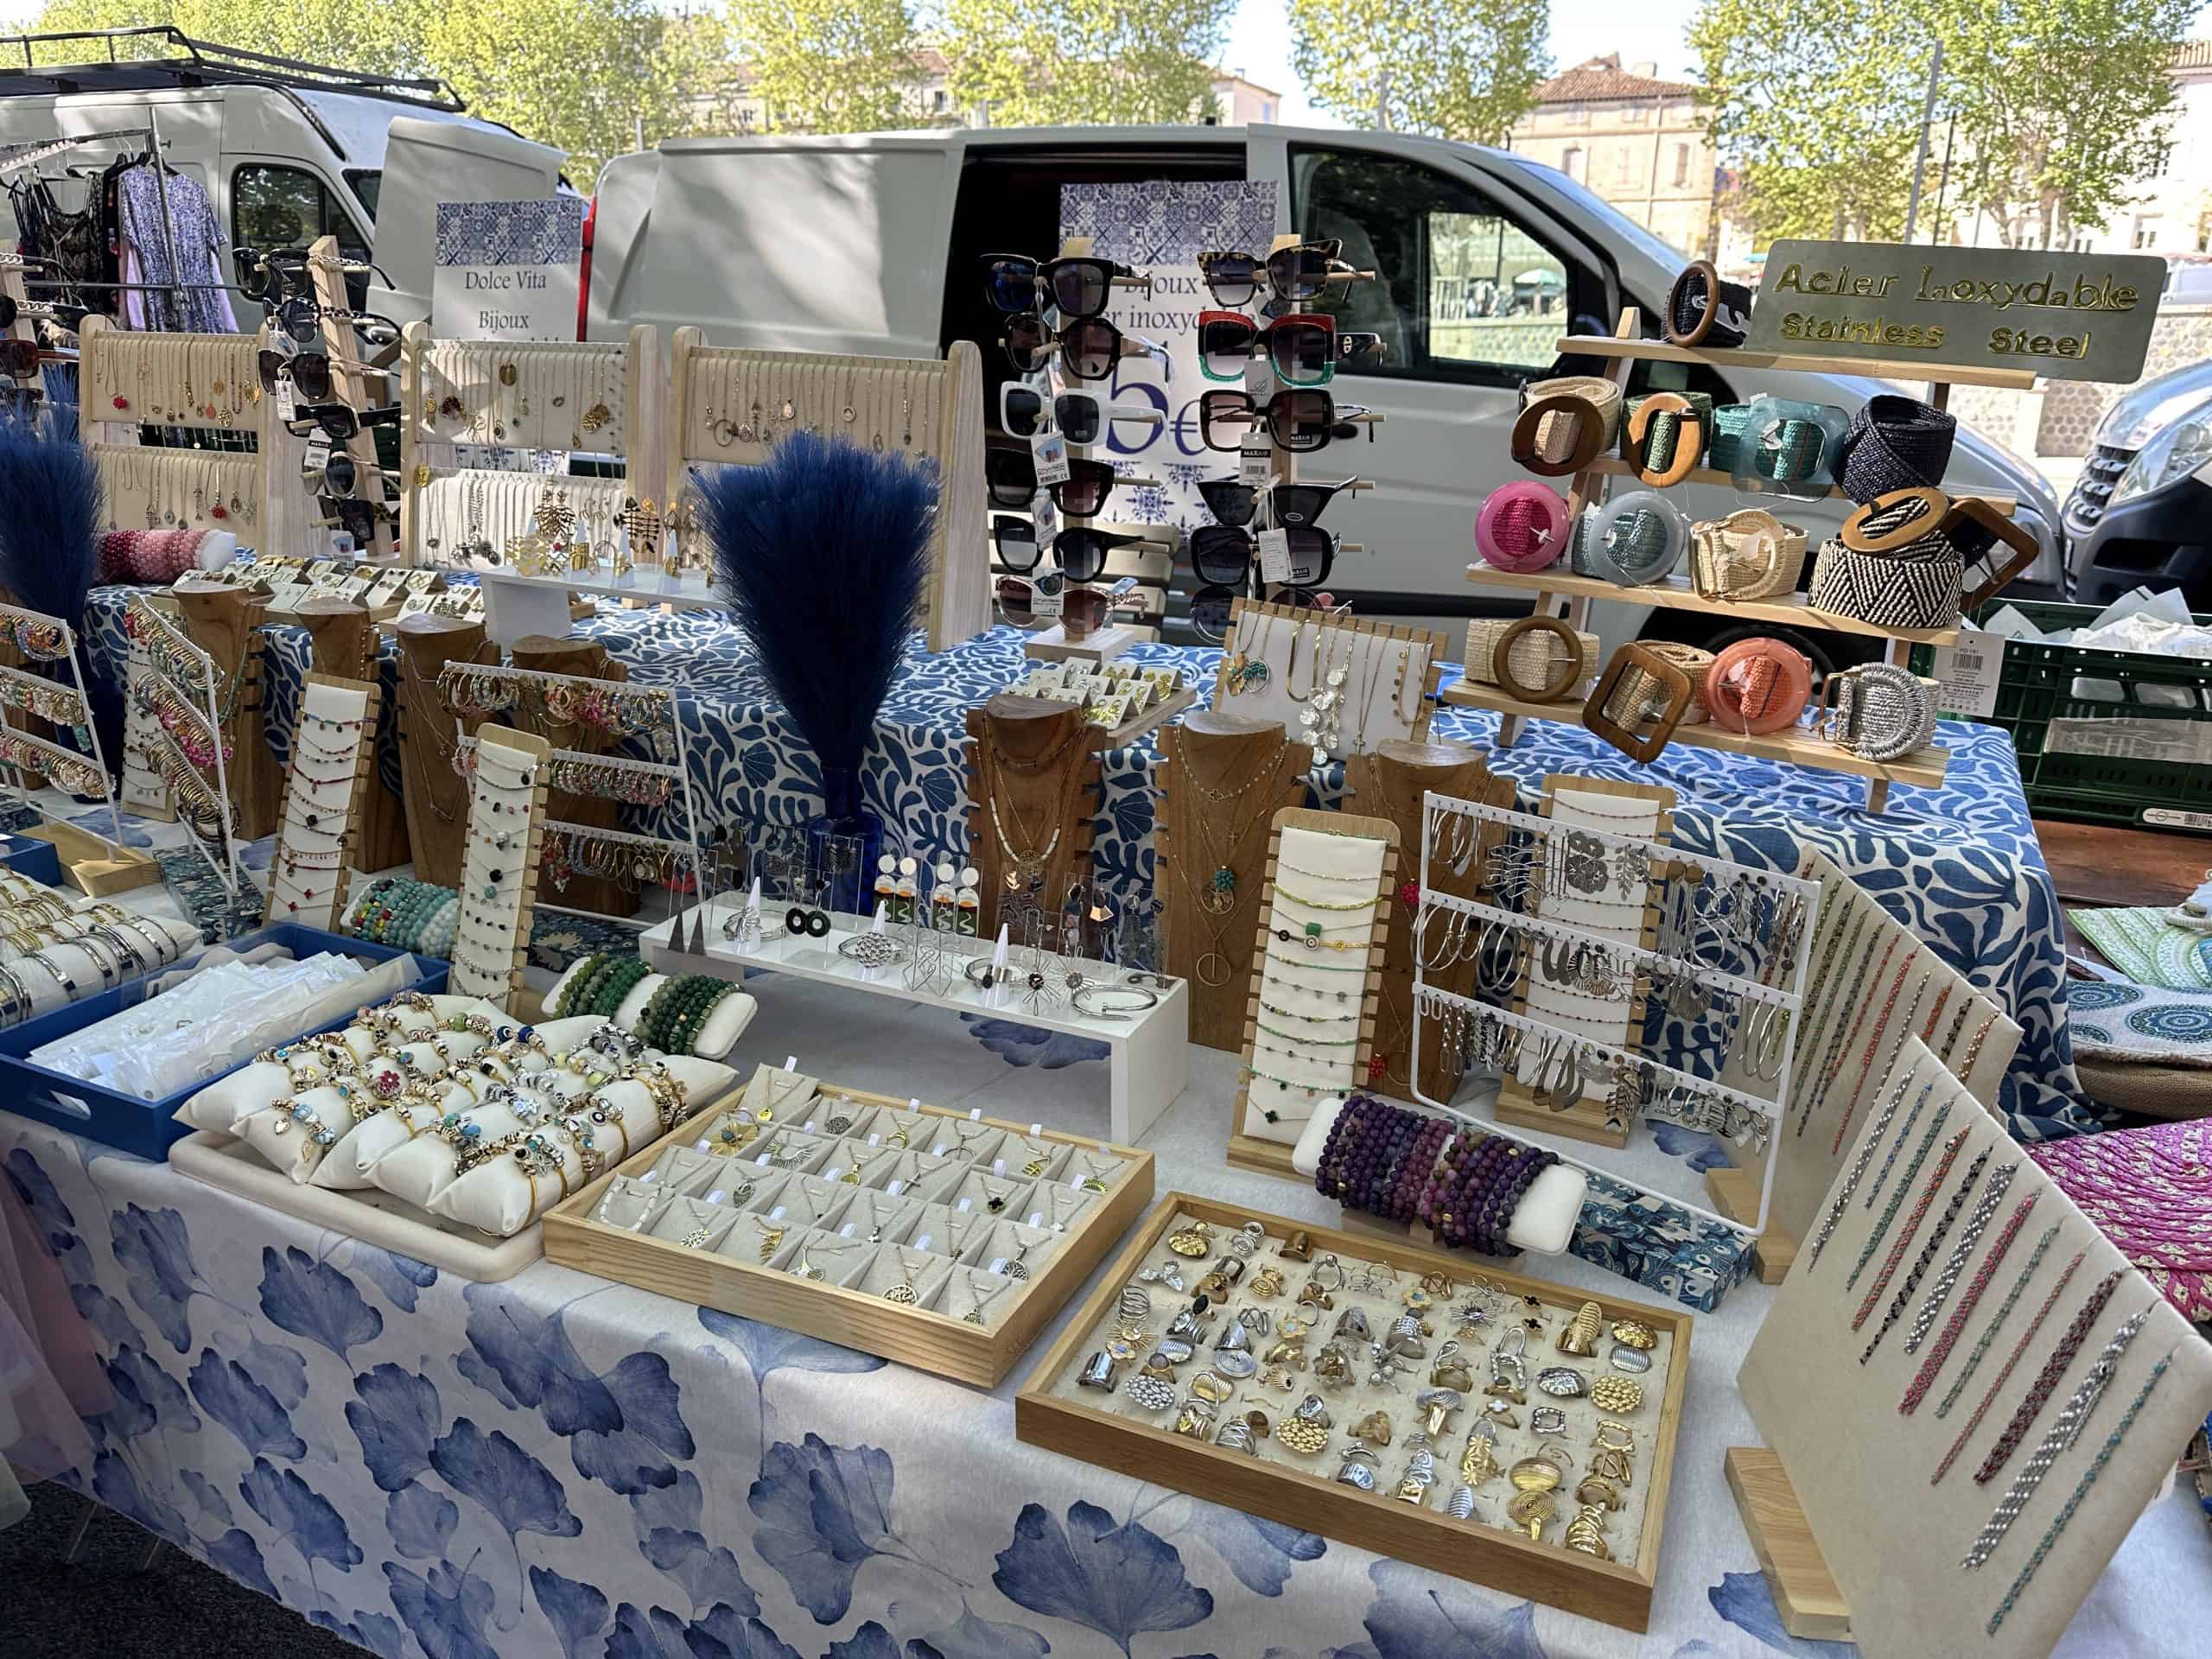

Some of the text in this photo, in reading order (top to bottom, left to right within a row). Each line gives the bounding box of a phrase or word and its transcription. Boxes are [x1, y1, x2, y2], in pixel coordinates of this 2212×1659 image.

[465, 270, 547, 289] Dolce Vita
[1124, 270, 1198, 300] Bioux
[1773, 263, 2139, 311] Acier Inoxydable
[478, 310, 530, 334] Bijoux
[1782, 312, 2091, 359] Stainless Steel
